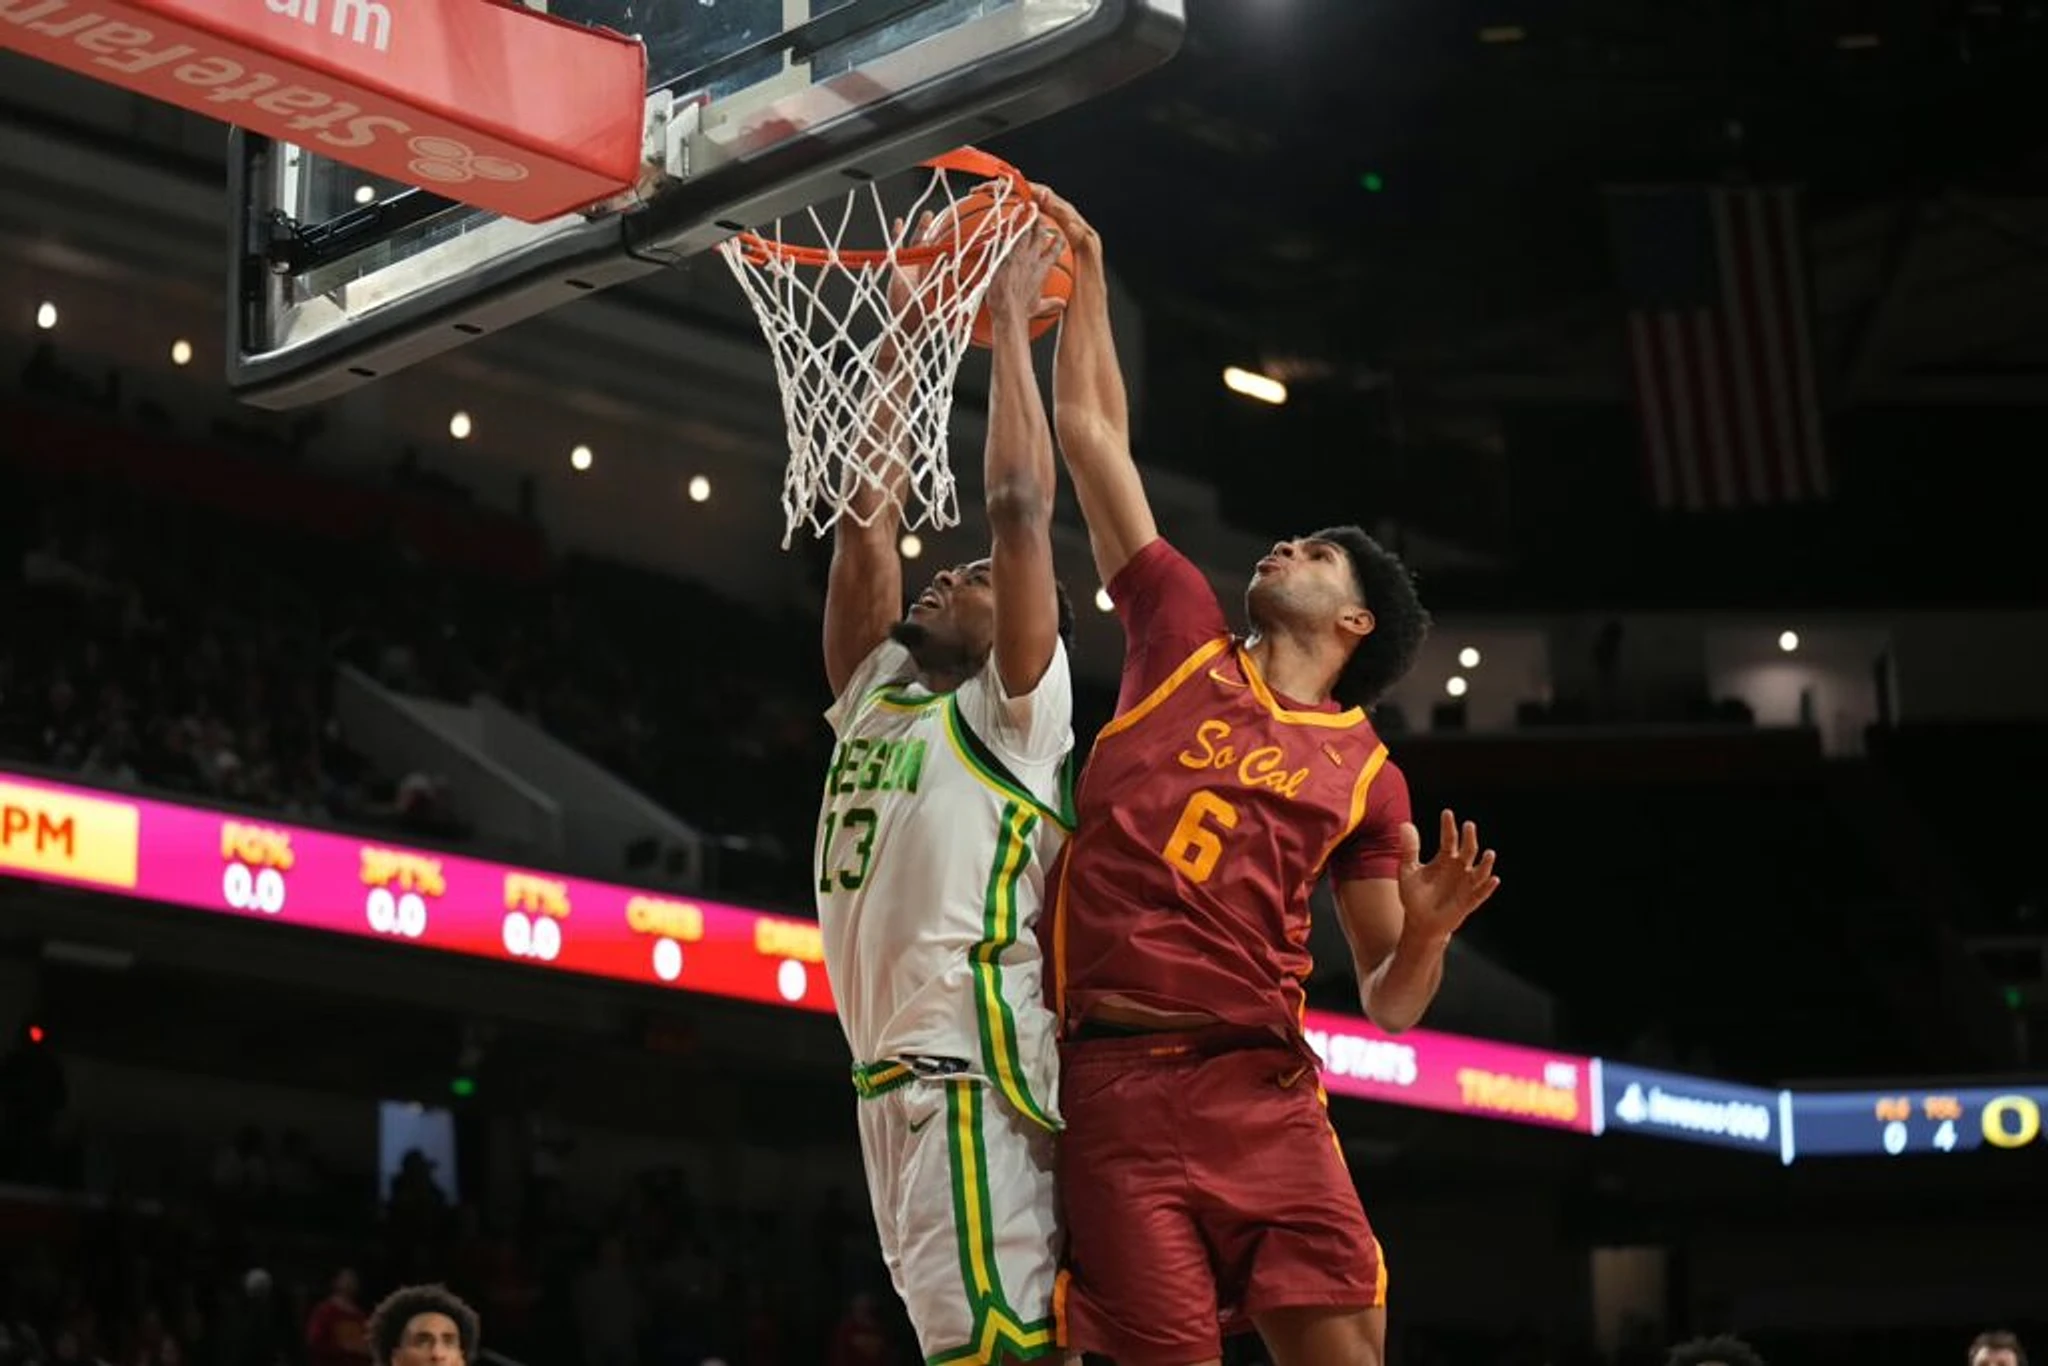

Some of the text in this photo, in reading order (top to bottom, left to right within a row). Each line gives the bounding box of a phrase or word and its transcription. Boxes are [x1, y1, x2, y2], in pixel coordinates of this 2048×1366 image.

[829, 737, 928, 797] REGON
[1178, 719, 1237, 769] So
[1238, 746, 1309, 798] Cal
[2, 804, 75, 861] PM
[819, 808, 878, 892] 13
[1162, 789, 1239, 883] 6
[223, 862, 286, 915] 0.0
[366, 887, 428, 938] 0.0
[502, 911, 561, 961] 0.0
[653, 937, 683, 981] 0
[777, 959, 807, 1002] 0
[1883, 1120, 1907, 1155] 0
[1932, 1119, 1958, 1152] 4
